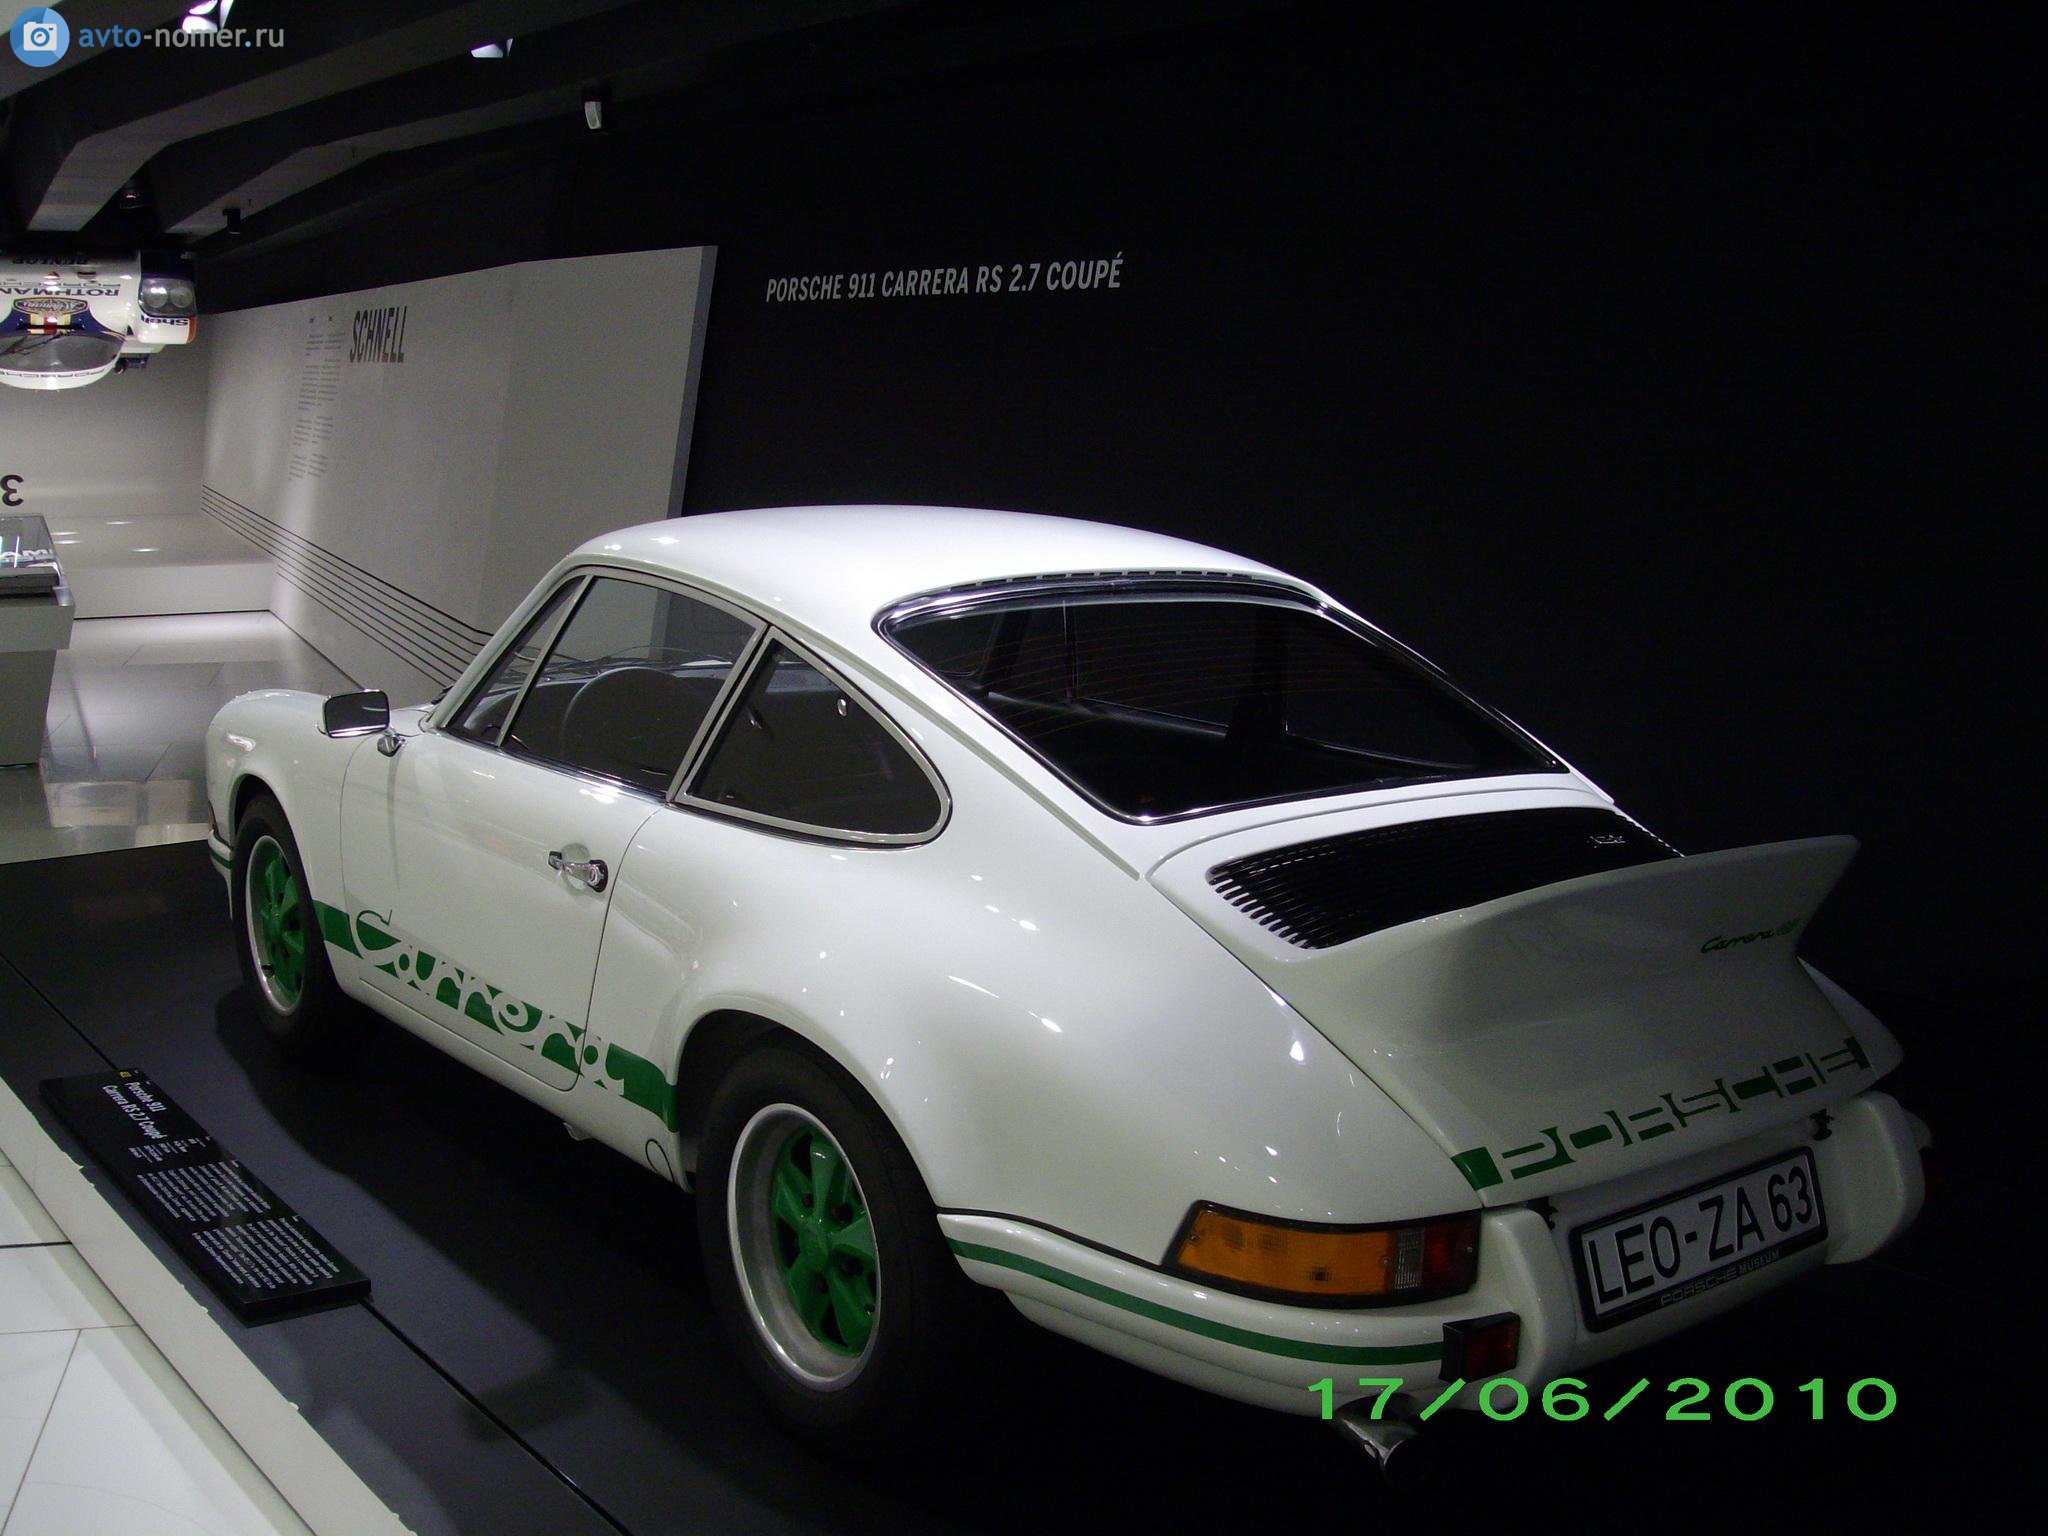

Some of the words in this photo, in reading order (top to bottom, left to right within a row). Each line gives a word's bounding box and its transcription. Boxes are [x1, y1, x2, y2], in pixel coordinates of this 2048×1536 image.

[766, 273, 844, 302] PORSCHE
[848, 272, 876, 299] 911
[881, 268, 969, 298] CARRERA
[975, 264, 1003, 293] RS
[1008, 262, 1041, 292] 2.7
[1046, 251, 1124, 291] COUPÉ
[140, 314, 189, 326] Shell
[349, 305, 408, 363] SCHNELL
[1700, 928, 1775, 954] Carrera
[350, 908, 626, 1099] Carrera
[101, 1084, 129, 1105] Carrera
[120, 1103, 141, 1113] RS
[124, 1081, 154, 1103] Porsche
[145, 1101, 167, 1113] 911
[1488, 1036, 1868, 1182] PORSCHE
[1767, 1165, 1813, 1233] 63
[1661, 1268, 1738, 1306] PORSCHE
[1739, 1247, 1781, 1277] MUSEUM
